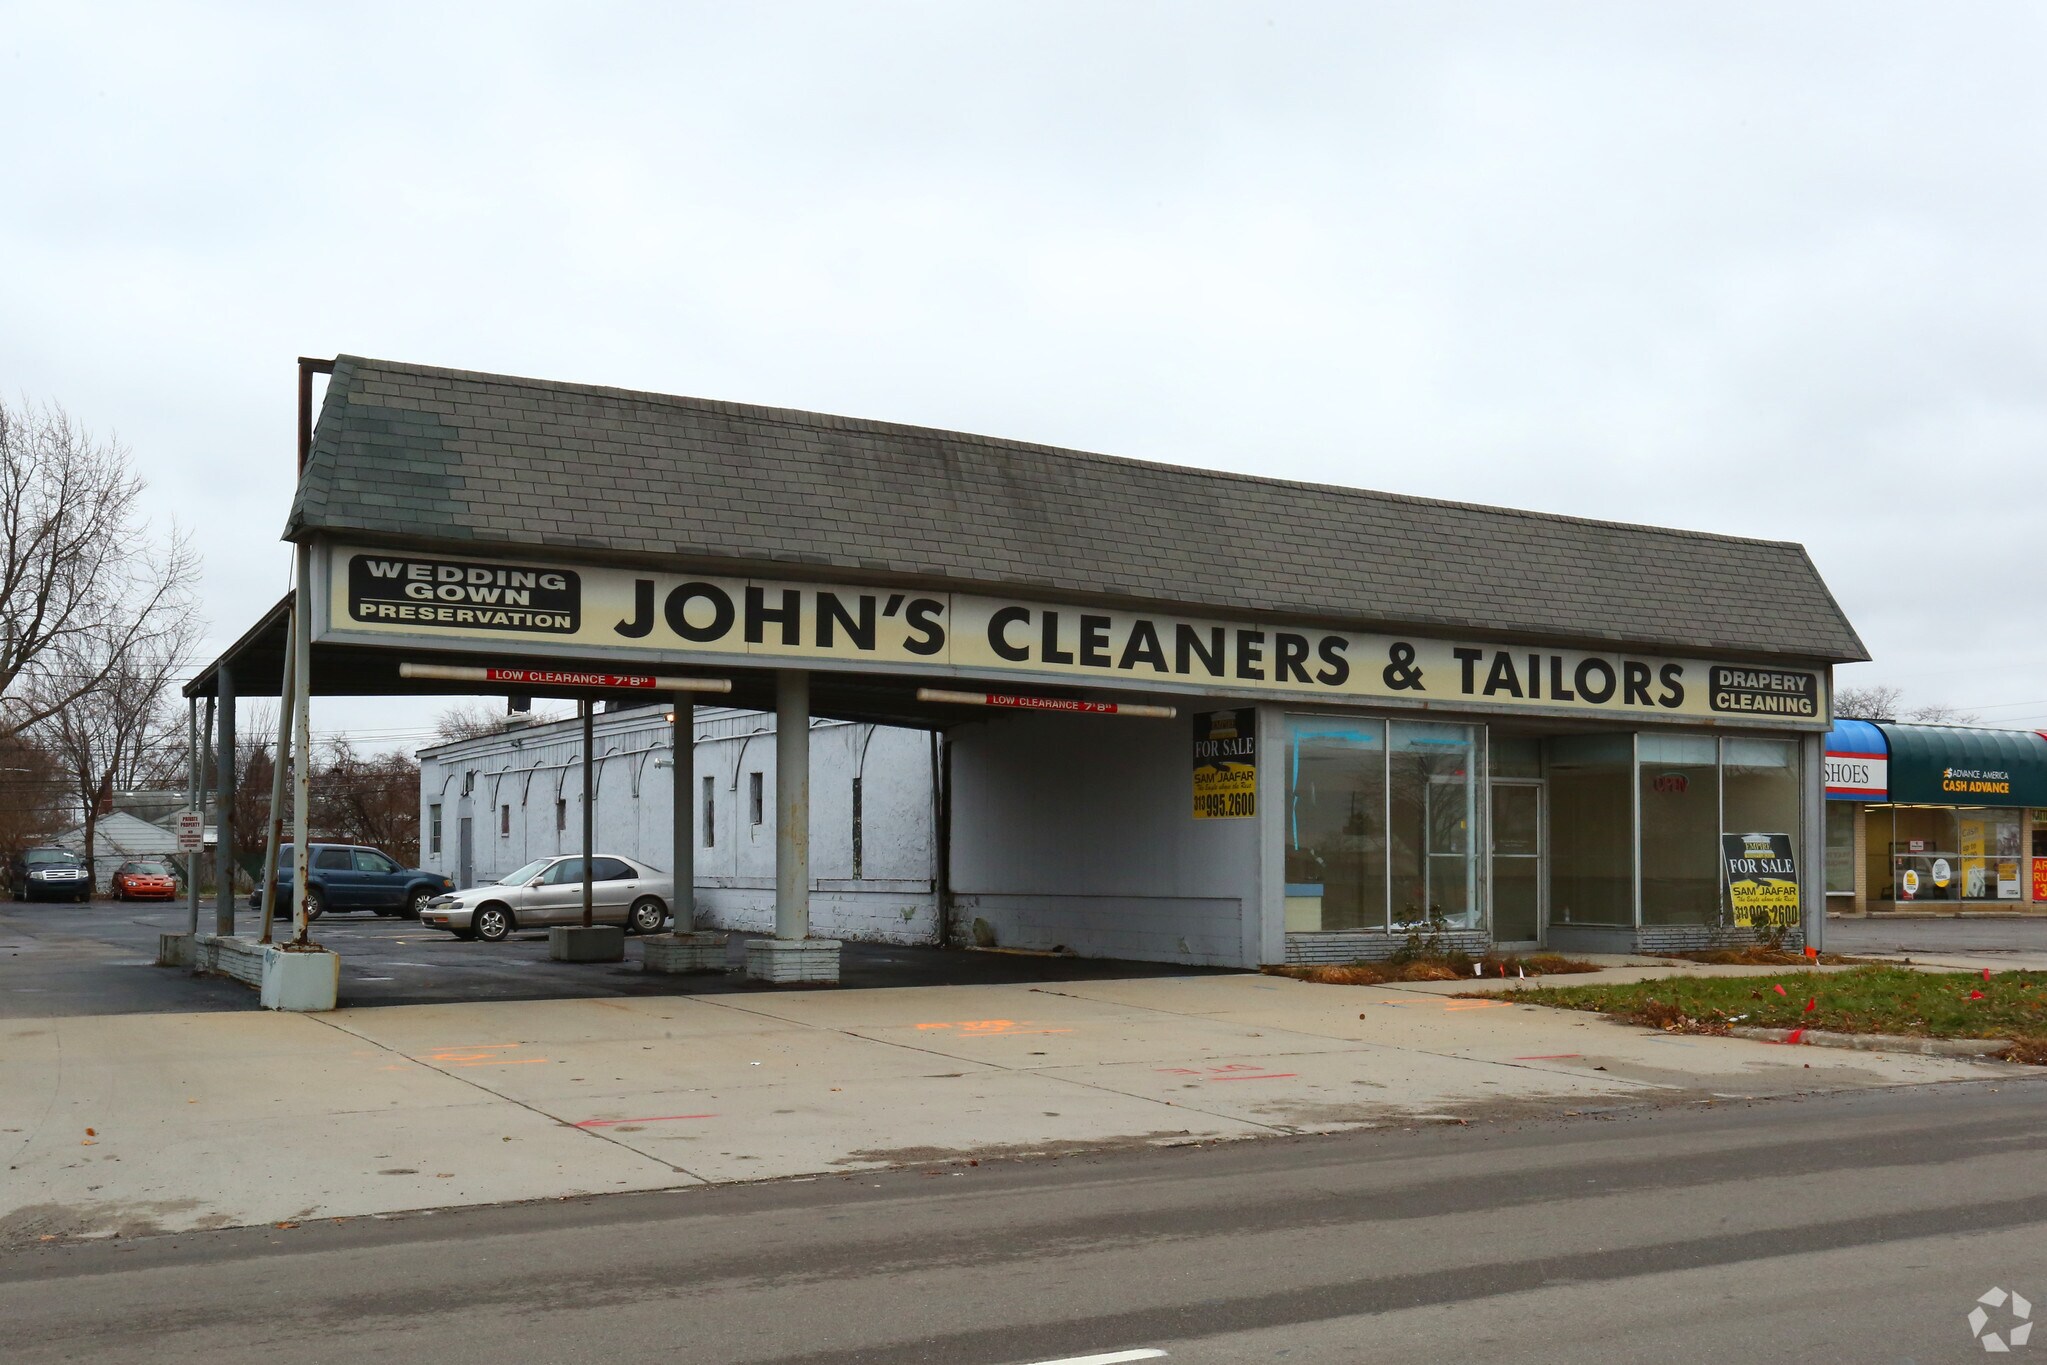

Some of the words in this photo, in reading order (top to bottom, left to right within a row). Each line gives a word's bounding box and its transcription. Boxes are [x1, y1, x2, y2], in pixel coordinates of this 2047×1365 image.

[366, 560, 567, 591] WEDDING
[404, 581, 531, 606] GOWN
[360, 603, 571, 629] PRESERVATION
[613, 579, 946, 656] JOHN'S
[987, 605, 1351, 687] CLEANERS
[1382, 641, 1427, 692] &
[1453, 647, 1685, 709] TAILORS
[495, 670, 524, 680] LOW
[529, 672, 606, 685] CLEARANCE
[1719, 670, 1807, 692] DRAPERY
[993, 695, 1015, 704] LOW
[1019, 697, 1079, 710] CLEARANCE
[1716, 692, 1812, 714] CLEANING
[1195, 740, 1219, 758] FOR
[1223, 737, 1254, 756] SALE
[1194, 773, 1215, 784] SAM
[1217, 771, 1254, 782] JAAFAR
[1825, 763, 1869, 784] SHOES
[1952, 769, 1981, 779] ADVANCE
[1982, 771, 2009, 780] AMERICA
[1655, 776, 1688, 792] OPEN
[1943, 780, 1967, 791] CASH
[1968, 781, 2010, 793] ADVANCE
[1194, 795, 1206, 811] 313
[1206, 792, 1255, 817] 995.2600
[1730, 859, 1758, 873] FOR
[1761, 859, 1794, 873] SALE
[1733, 887, 1756, 896] SAM
[1759, 887, 1796, 896] JAAFAR
[1735, 905, 1749, 920] 313
